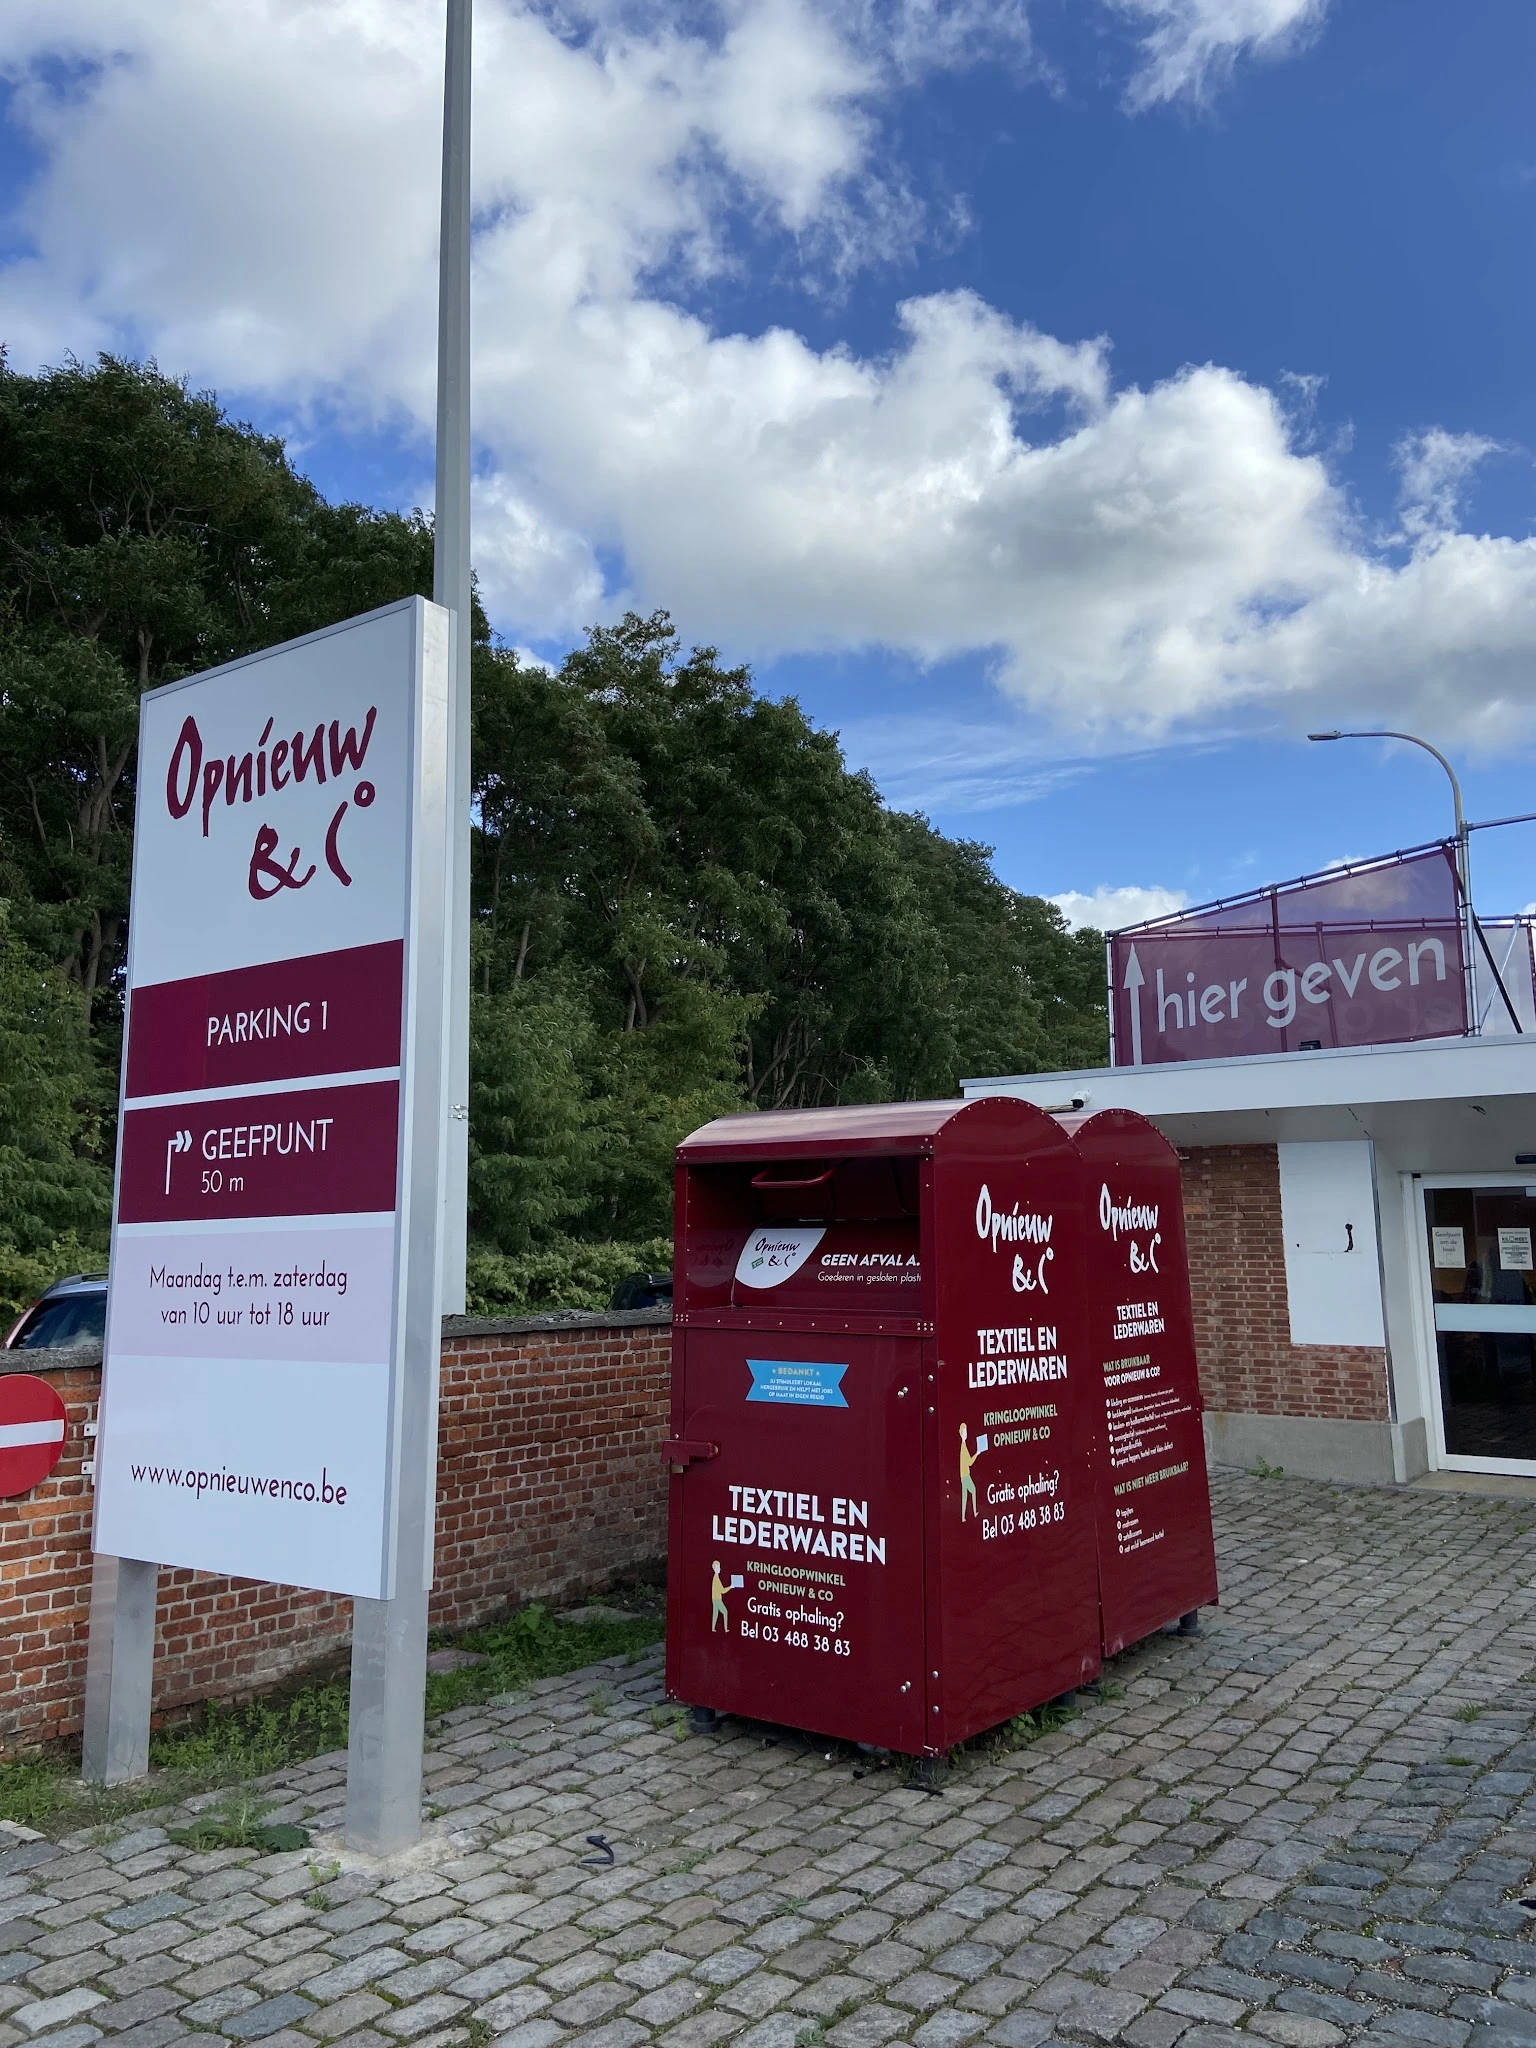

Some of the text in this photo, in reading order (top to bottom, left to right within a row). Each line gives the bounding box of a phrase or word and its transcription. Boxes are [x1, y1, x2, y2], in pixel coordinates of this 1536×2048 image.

[249, 824, 316, 900] &
[1156, 938, 1445, 1032] hier geven
[207, 1001, 328, 1046] PARKING 1
[202, 1119, 333, 1160] GEEFPUNT
[201, 1170, 244, 1193] 50 m
[769, 1255, 782, 1266] &
[821, 1254, 858, 1265] GEEN
[860, 1254, 903, 1266] AFVAL
[1130, 1240, 1149, 1273] &
[150, 1260, 348, 1296] Maandag t.e.m. zaterdag
[818, 1271, 854, 1282] Goederen
[857, 1274, 864, 1282] in
[867, 1272, 898, 1284] gesloten
[1013, 1254, 1037, 1292] &
[161, 1302, 330, 1326] van 10 uur tot 18 uur
[1117, 1302, 1158, 1320] TEXTIEL EN
[978, 1327, 1057, 1354] TEXTIEL EN
[1113, 1318, 1164, 1339] LEDERWAREN
[778, 1368, 814, 1376] BEDANKT
[969, 1355, 1067, 1388] LEDERWAREN
[1103, 1361, 1114, 1372] WAT
[1115, 1360, 1120, 1370] IS
[1104, 1375, 1120, 1387] VOOR
[1146, 1368, 1150, 1378] &
[984, 1404, 1057, 1426] KRINGLOOPWINKEL
[994, 1426, 1050, 1446] OPNIEUW & CO
[132, 1465, 347, 1504] www.opnieuwenco.be
[987, 1470, 1059, 1504] Gratis ophaling?
[1114, 1484, 1125, 1496] WAT
[1126, 1481, 1131, 1492] IS
[1132, 1476, 1144, 1490] NIET
[1145, 1472, 1159, 1485] MEER
[729, 1485, 867, 1528] TEXTIEL EN
[983, 1502, 1064, 1540] Bel 03 488 38 83
[713, 1515, 885, 1565] LEDERWAREN
[747, 1561, 846, 1586] KRINGLOOPWINKEL
[758, 1580, 833, 1601] OPNIEUW & CO
[747, 1597, 844, 1632] Gratis ophaling?
[741, 1621, 850, 1656] Bel 03 488 38 83
